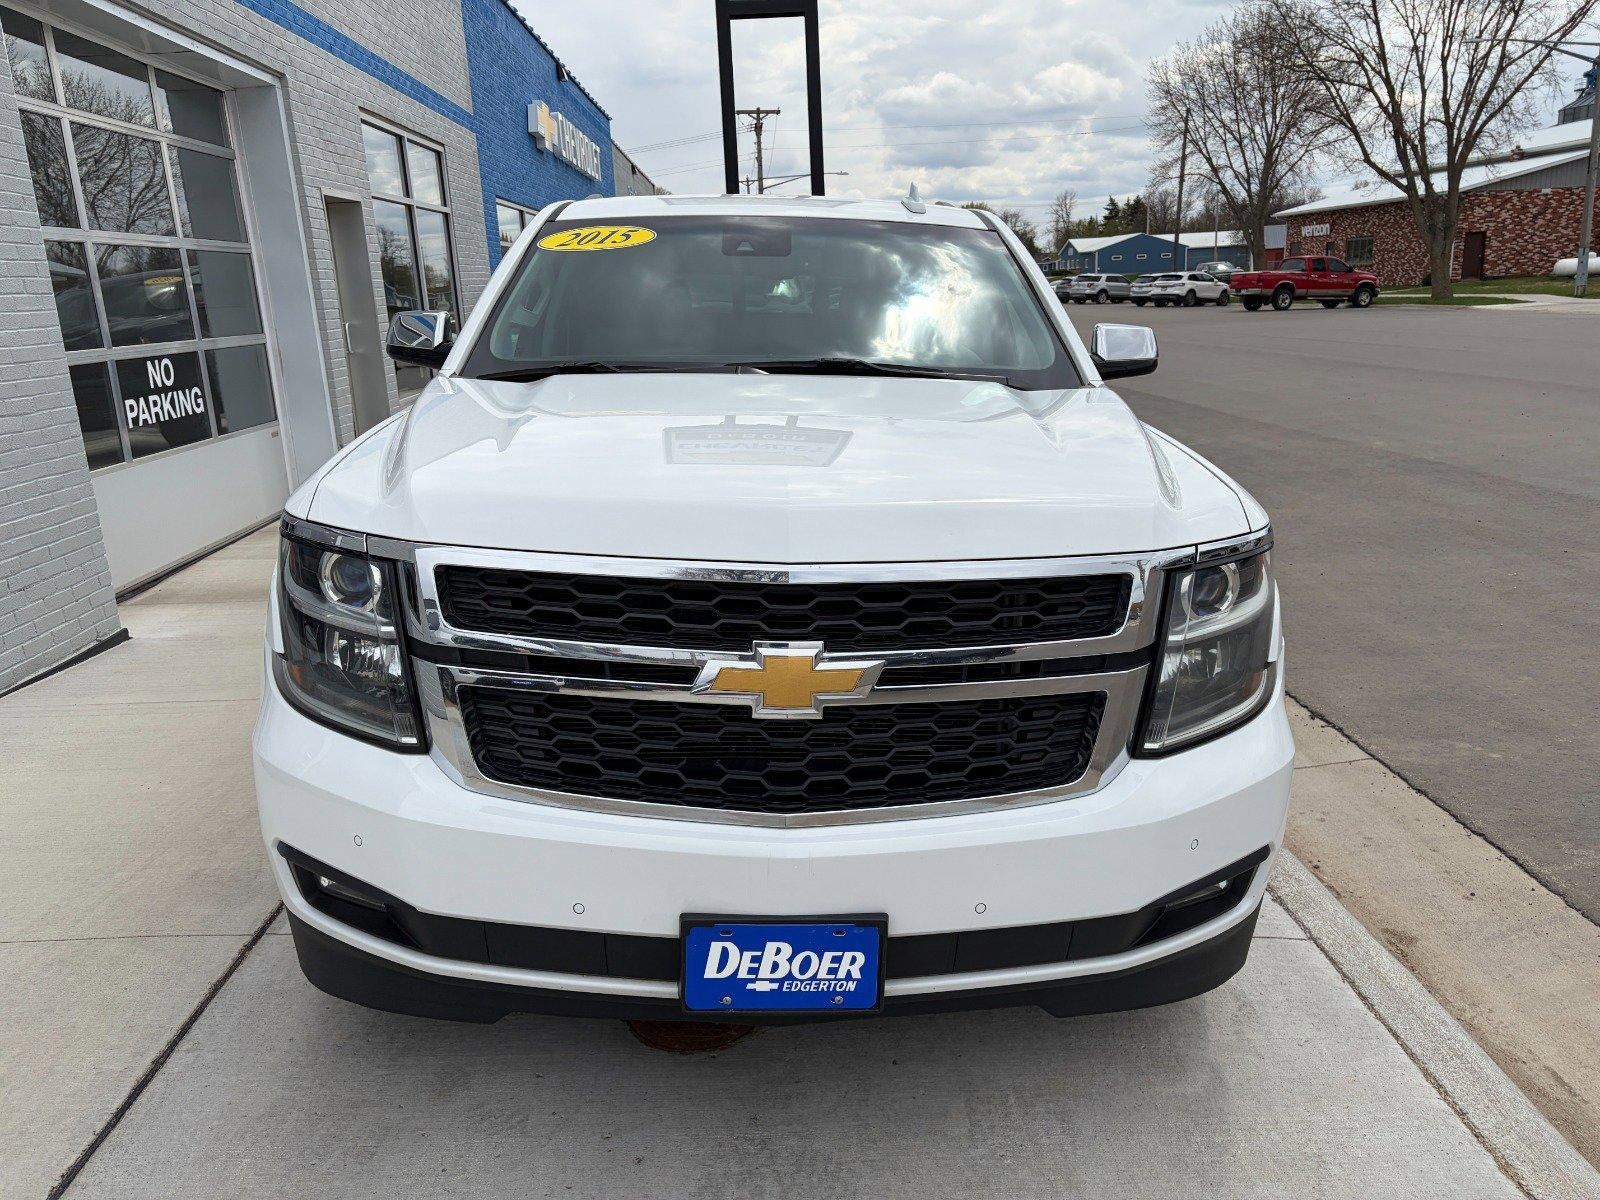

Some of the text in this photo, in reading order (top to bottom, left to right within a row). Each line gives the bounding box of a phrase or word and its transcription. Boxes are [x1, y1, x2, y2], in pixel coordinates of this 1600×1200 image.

[555, 229, 640, 248] 2015
[1301, 221, 1331, 238] verizon
[146, 357, 175, 389] NO
[124, 386, 205, 429] PARKING
[782, 980, 858, 992] EDGERTON
